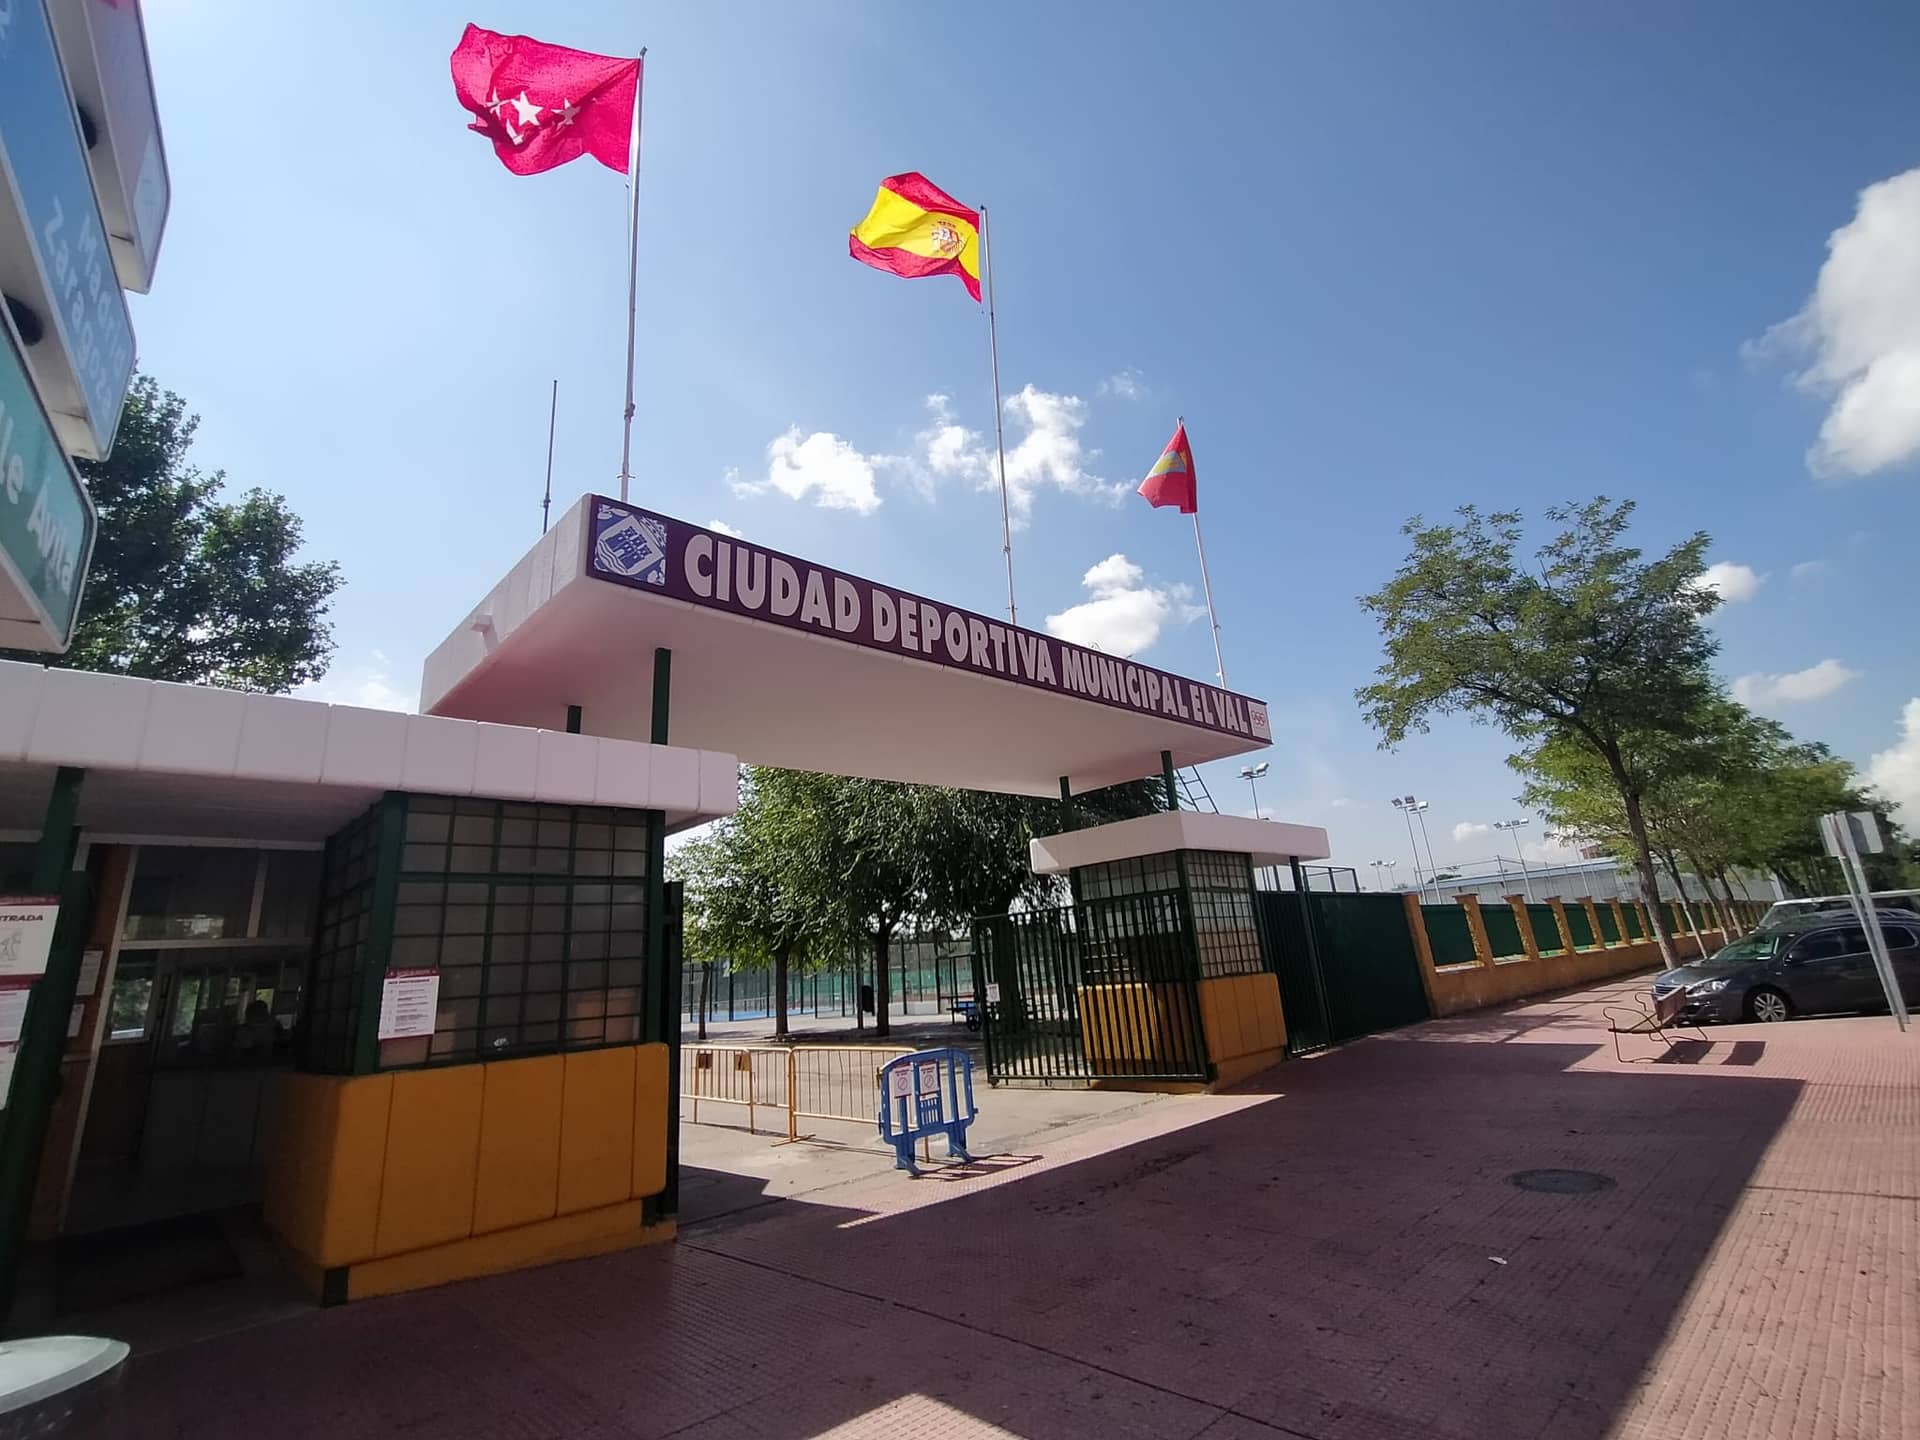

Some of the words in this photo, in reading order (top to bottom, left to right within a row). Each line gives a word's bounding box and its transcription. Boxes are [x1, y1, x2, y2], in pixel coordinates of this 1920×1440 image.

[44, 195, 112, 421] Zaragoza
[684, 534, 861, 634] CIUDAD
[872, 589, 1057, 686] DEPORTIVA
[1061, 646, 1189, 720] MUNICIPAL
[1189, 684, 1215, 726] EL
[1215, 689, 1249, 735] VAL
